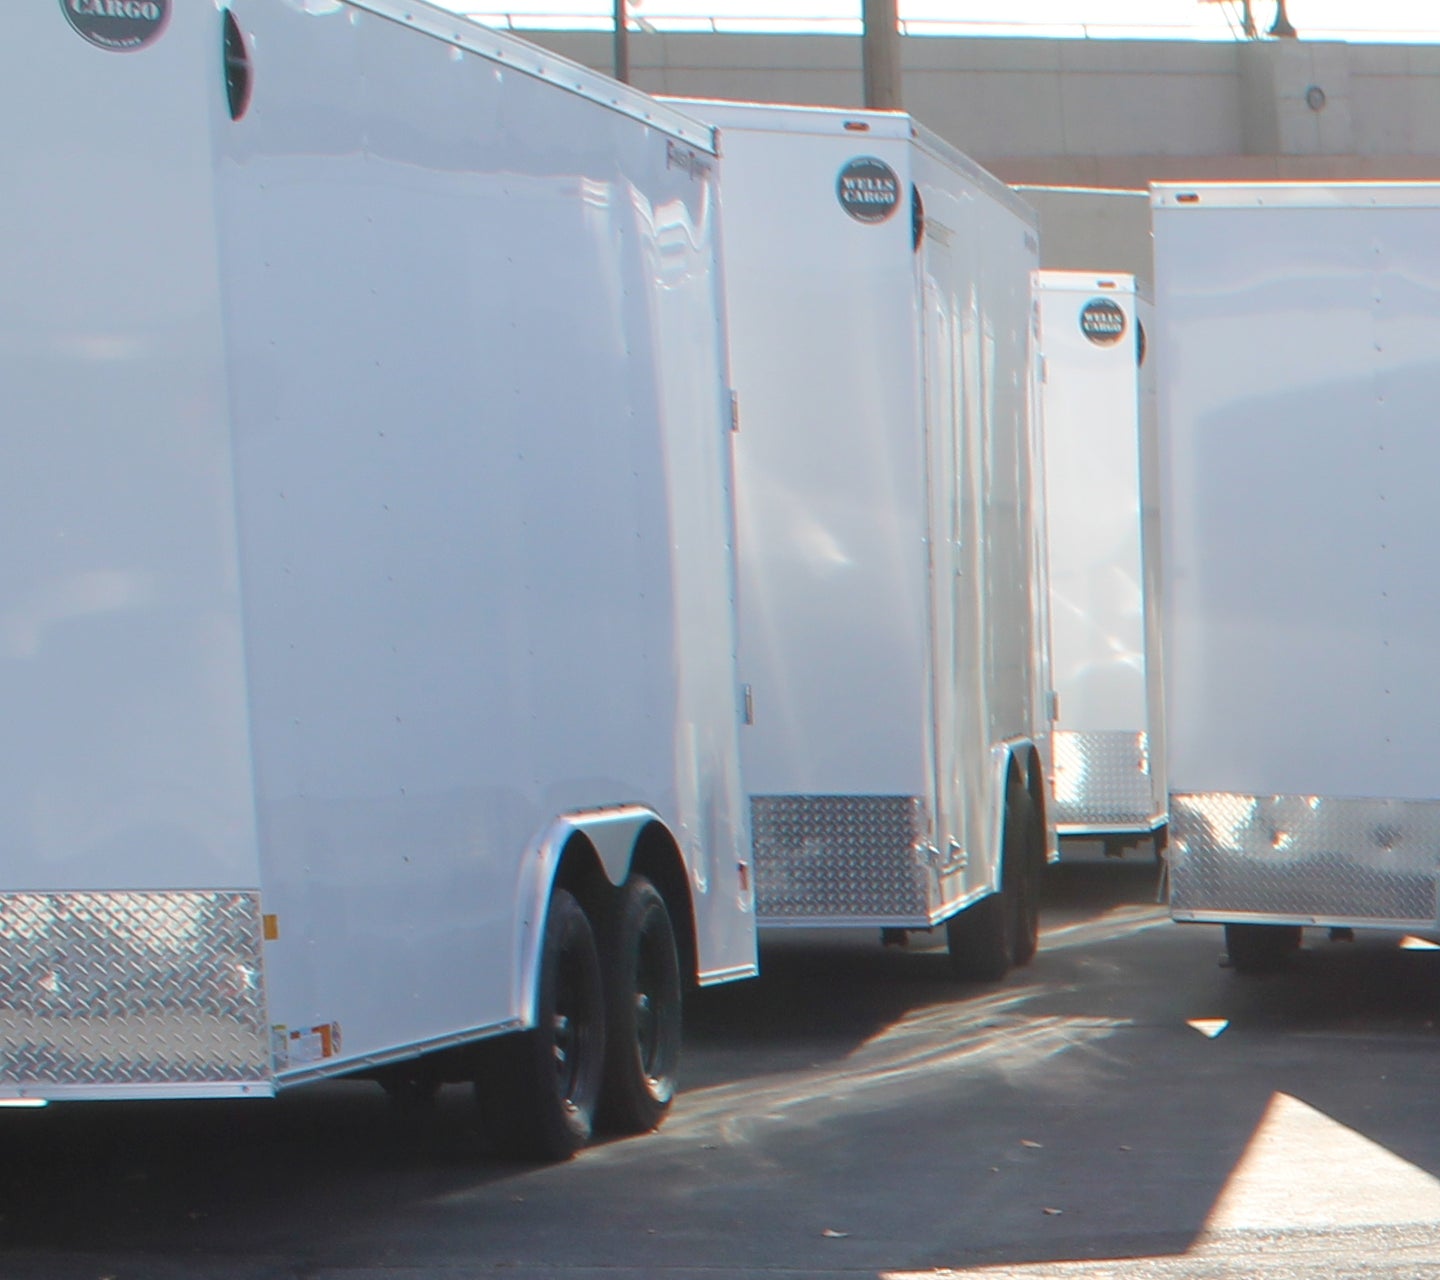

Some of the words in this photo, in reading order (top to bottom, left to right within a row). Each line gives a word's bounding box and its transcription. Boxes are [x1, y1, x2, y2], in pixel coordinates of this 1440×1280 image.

[72, 0, 161, 20] CARGO
[843, 177, 895, 189] WELLS
[842, 190, 896, 202] CARGO
